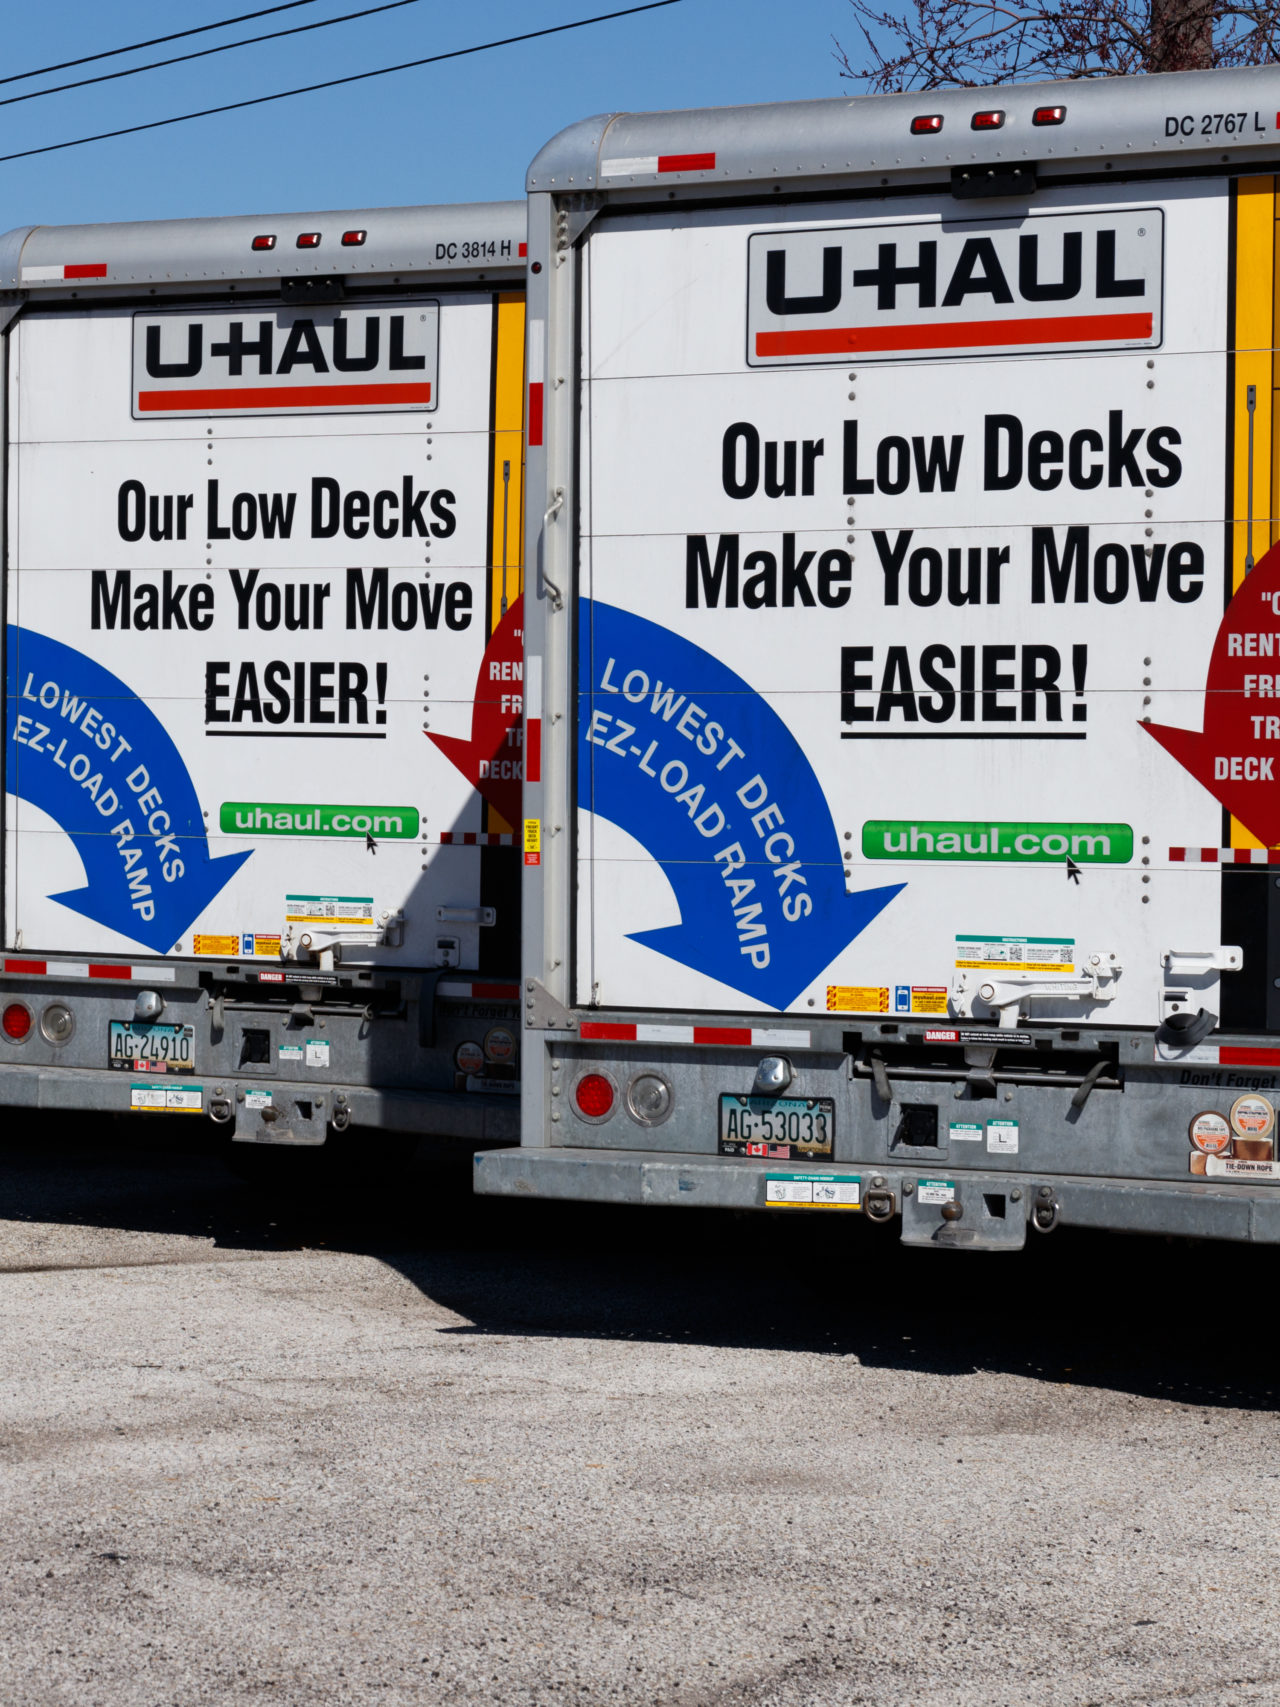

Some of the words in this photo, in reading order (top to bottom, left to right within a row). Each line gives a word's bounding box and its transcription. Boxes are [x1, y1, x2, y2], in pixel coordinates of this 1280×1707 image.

[1165, 116, 1194, 137] DC
[1201, 113, 1247, 134] 2767
[1254, 112, 1265, 131] L
[436, 243, 457, 260] DC
[462, 241, 496, 258] 3814
[501, 240, 511, 256] H
[766, 229, 1146, 316] U-HAUL
[145, 315, 426, 379] U-HAUL
[721, 421, 824, 500] Our
[842, 418, 965, 496] Low
[983, 409, 1182, 492] Decks
[117, 479, 194, 542] Our
[207, 479, 297, 540] Low
[310, 474, 457, 540] Decks
[90, 569, 215, 631] Make
[228, 568, 331, 631] Your
[345, 566, 474, 632] Move
[684, 532, 852, 610] Make
[871, 529, 1011, 608] Your
[1031, 524, 1206, 605] Move
[205, 660, 388, 725] EASIER!
[840, 643, 1088, 724] EASIER!
[22, 672, 132, 762] LOWEST
[125, 763, 185, 883] DECKS
[479, 760, 523, 779] DECK
[600, 657, 745, 772] LOWEST
[736, 773, 813, 923] DECKS
[1215, 756, 1275, 781] DECK
[12, 714, 118, 818] EZ-LOAD
[110, 818, 155, 922] RAMP
[235, 807, 403, 833] uhaul.com
[586, 709, 725, 838] EZ-LOAD
[713, 842, 771, 969] RAMP
[882, 826, 1111, 857] uhaul.com
[925, 1031, 956, 1041] DANGER
[1181, 1070, 1222, 1087] Don't
[1226, 1073, 1276, 1091] Forget
